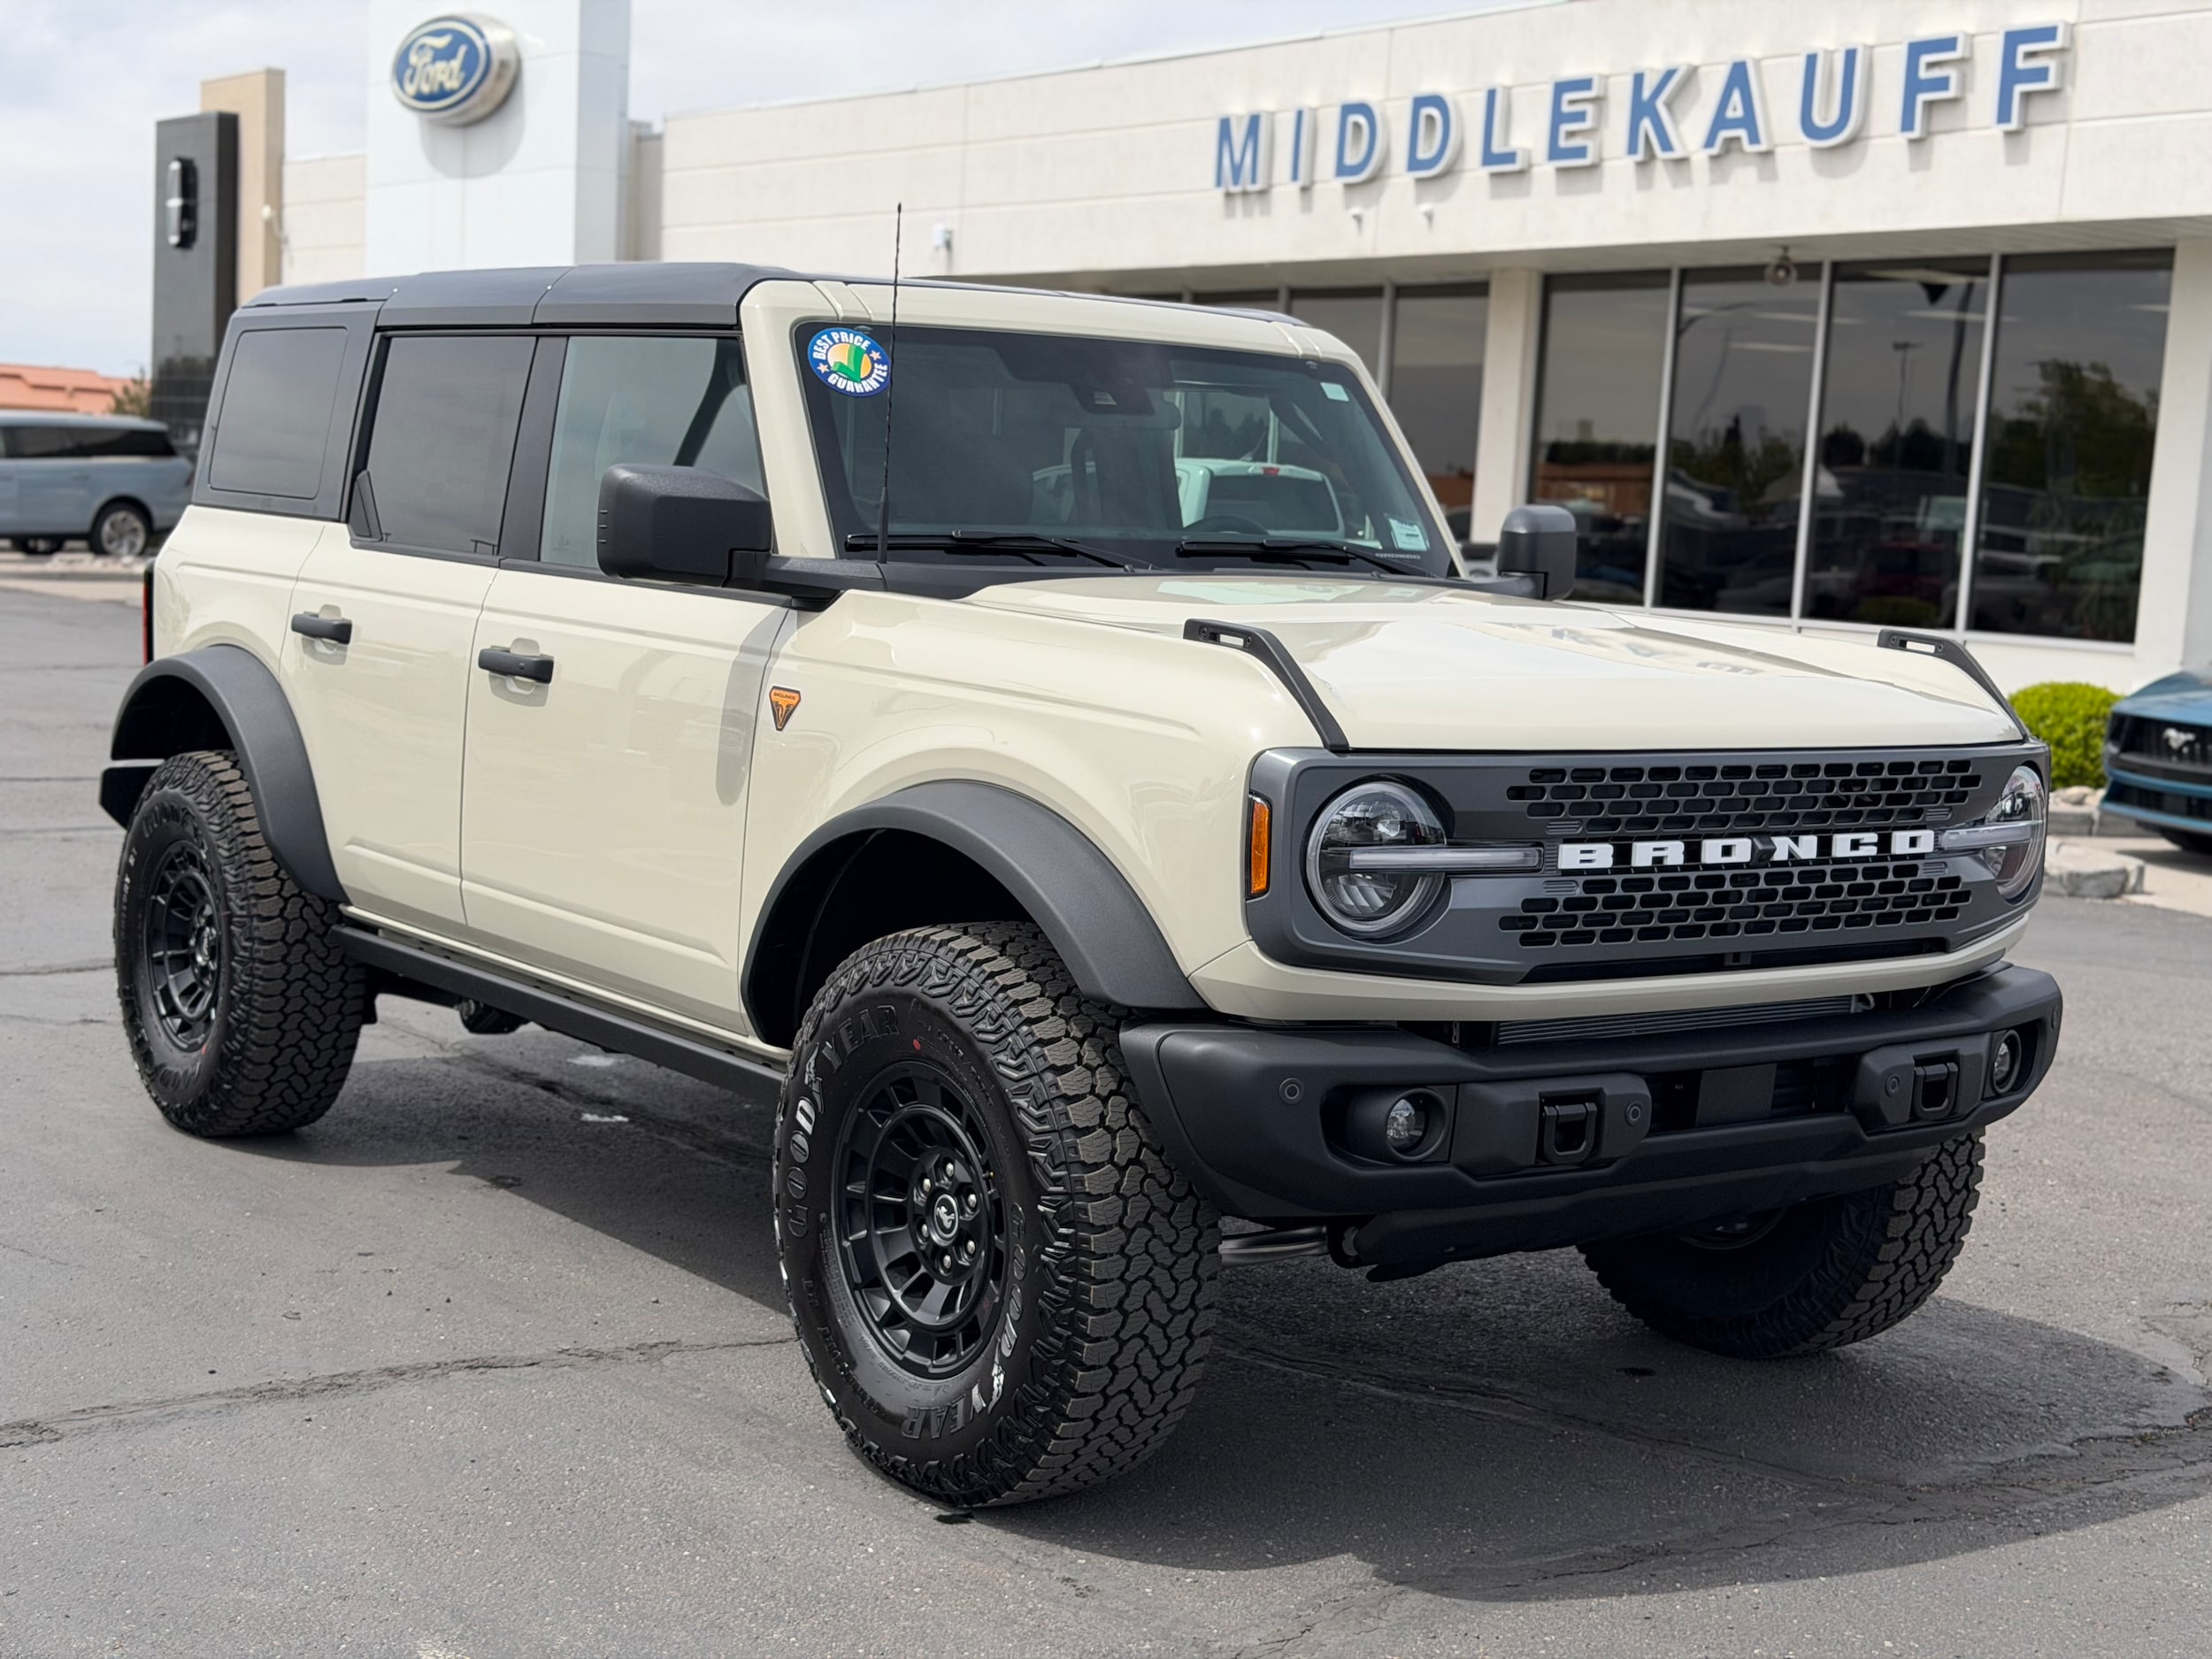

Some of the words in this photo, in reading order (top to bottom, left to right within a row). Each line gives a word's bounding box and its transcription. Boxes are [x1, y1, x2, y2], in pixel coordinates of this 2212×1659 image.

[403, 34, 467, 96] Ford
[1215, 21, 2072, 194] MIDDLEKAUFF
[812, 334, 833, 360] BEST
[830, 331, 871, 350] PRICE
[827, 363, 887, 393] GUARANTEE
[1558, 829, 1934, 869] BRONCO
